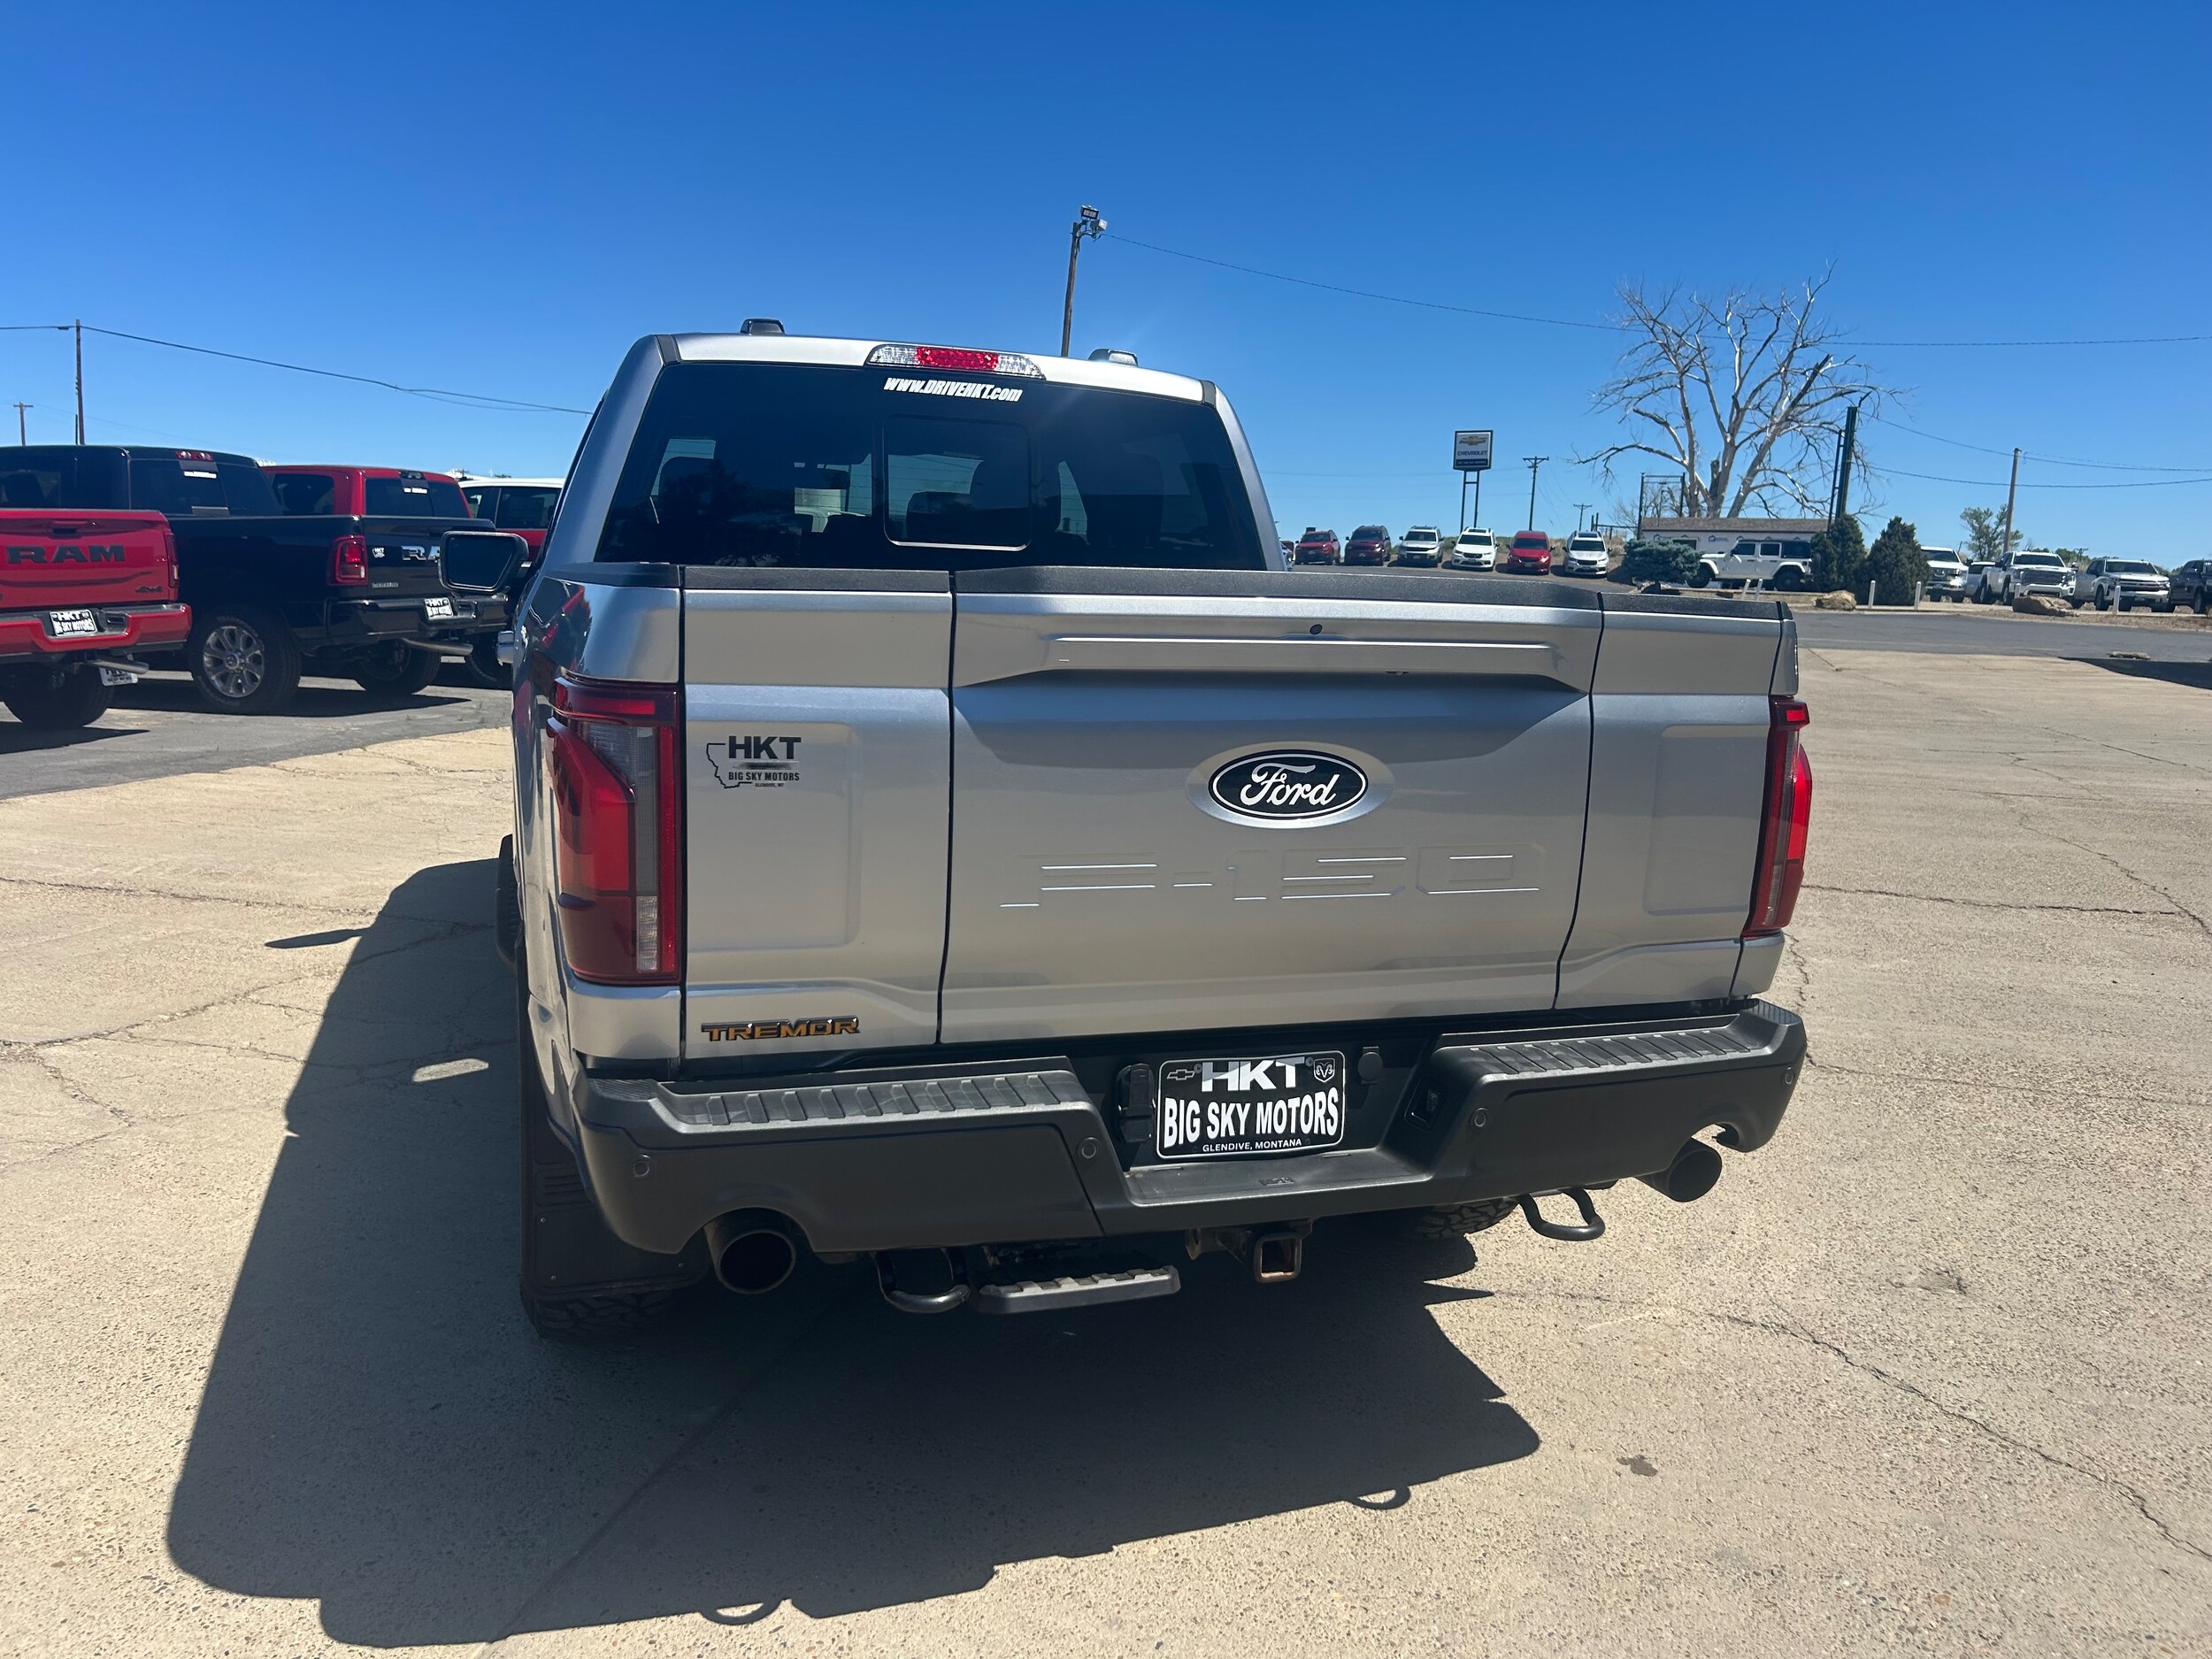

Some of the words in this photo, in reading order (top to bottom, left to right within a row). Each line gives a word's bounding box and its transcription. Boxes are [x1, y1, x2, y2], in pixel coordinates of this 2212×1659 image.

[884, 378, 1023, 402] www.DRIVEHKT.com
[7, 545, 125, 564] RAM
[58, 611, 81, 621] HKT
[728, 735, 802, 760] HKT
[728, 772, 743, 780] BIG
[745, 772, 763, 781] SKY
[764, 772, 800, 781] MOTORS
[1240, 762, 1340, 807] Ford
[999, 842, 1547, 908] F-150
[701, 1015, 860, 1042] TREMOR
[1201, 1056, 1305, 1093] HKT
[1164, 1096, 1201, 1148] BIG
[1206, 1102, 1251, 1140] SKY
[1256, 1087, 1339, 1137] MOTORS
[1202, 1141, 1253, 1153] GLENDIVE,
[1255, 1138, 1302, 1150] MONTANA
